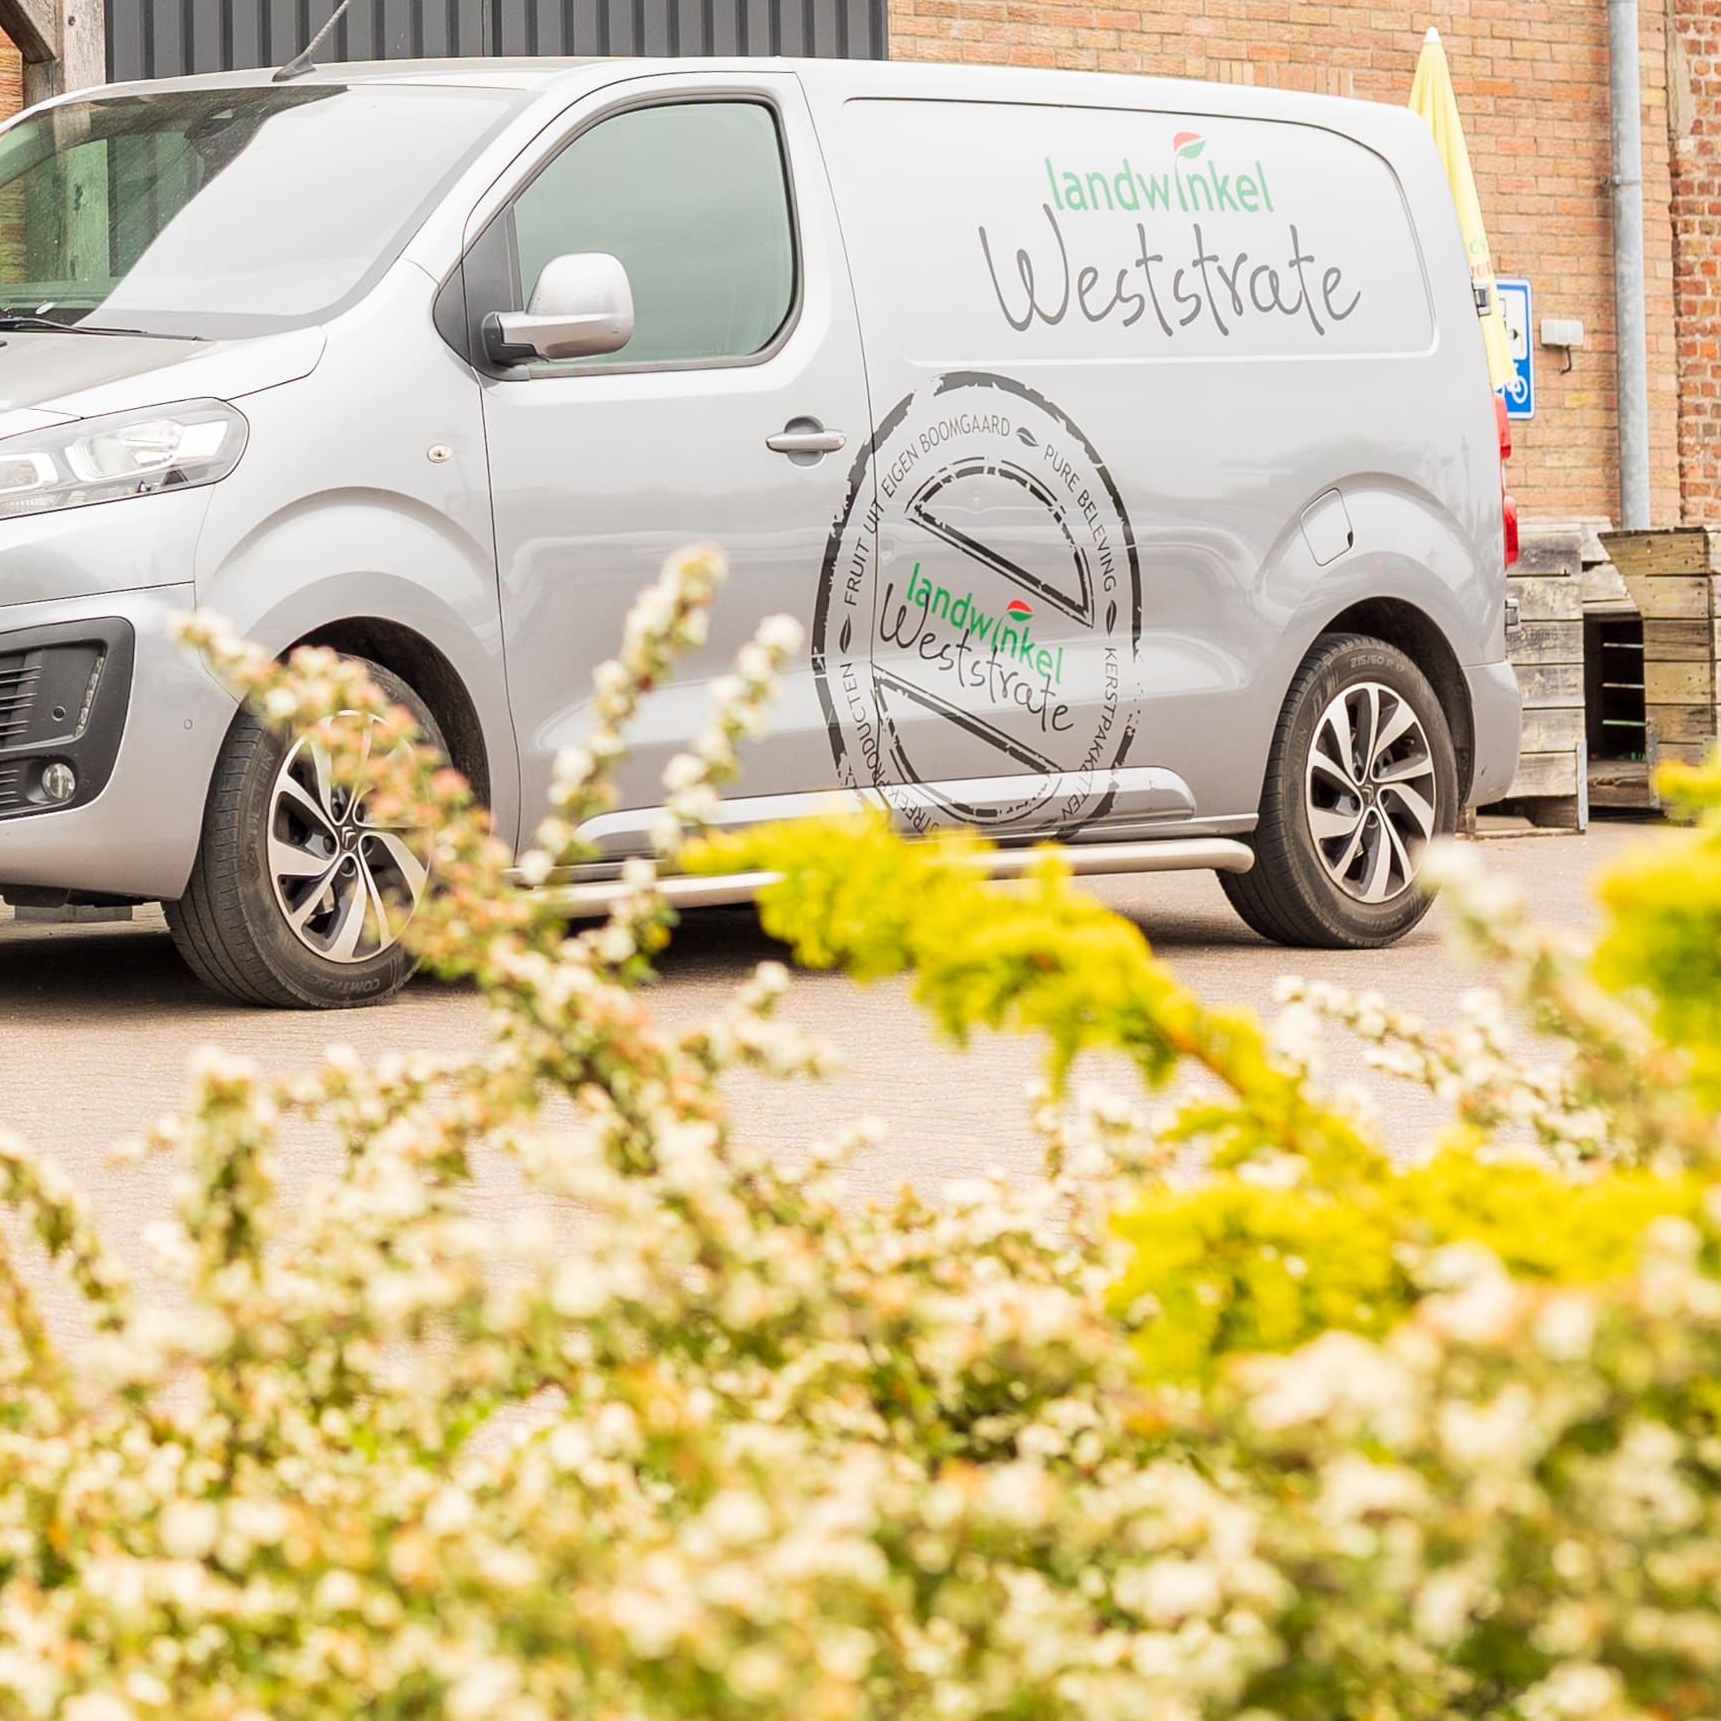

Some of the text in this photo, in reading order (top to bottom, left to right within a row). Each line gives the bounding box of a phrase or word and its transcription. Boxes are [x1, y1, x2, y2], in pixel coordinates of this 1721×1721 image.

[1044, 156, 1275, 214] landwinkel
[978, 203, 1361, 337] Weststrate
[844, 413, 1012, 606] FRUIT UIT EIGEN BOOMGAARD
[1043, 444, 1118, 593] PURE BELEVING
[879, 582, 1075, 733] Weststrate
[906, 562, 1063, 684] landwinkel
